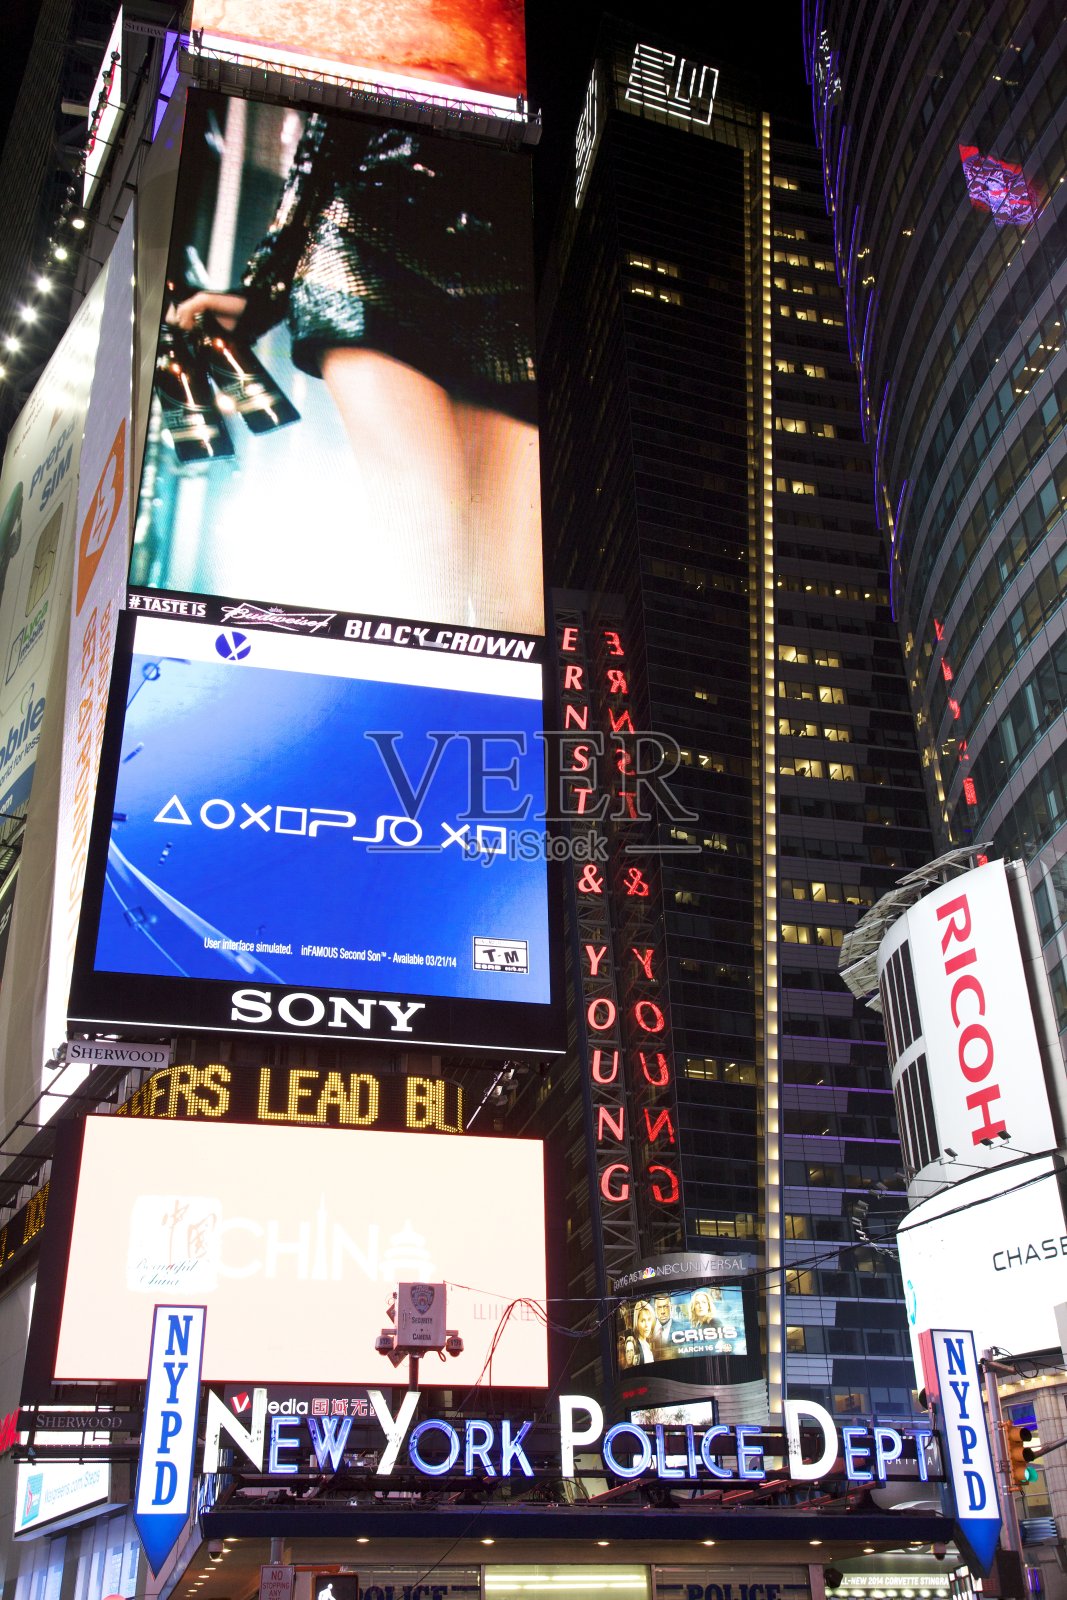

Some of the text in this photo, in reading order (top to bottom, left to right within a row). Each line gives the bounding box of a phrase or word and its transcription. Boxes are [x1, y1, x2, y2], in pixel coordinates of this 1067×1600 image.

[124, 22, 165, 37] SHERW
[39, 443, 73, 512] SIM
[191, 603, 206, 617] IS
[221, 604, 535, 660] Budweiser BLACK CROWN
[562, 627, 629, 1202] ERNST & YOUNG
[204, 937, 221, 949] User
[222, 938, 254, 952] interface
[256, 941, 293, 955] simulated.
[301, 945, 339, 959] inFAMOUS
[339, 948, 366, 961] Second
[393, 952, 424, 966] Available
[425, 955, 457, 968] 03/21/14
[231, 989, 425, 1032] SONY
[936, 893, 1007, 1146] RICOH
[71, 1045, 165, 1064] SHERWOOD
[258, 1067, 379, 1125] LEAD
[671, 1326, 738, 1344] CRISIS
[678, 1344, 714, 1354] MARCH 16
[151, 1314, 194, 1506] NYPD
[266, 1397, 309, 1415] edia
[311, 1397, 380, 1417] 国域无
[36, 1413, 123, 1429] SHERWOOD
[943, 1337, 989, 1512] NYPD
[203, 1387, 934, 1483] NEW YORK POLICE DEPT
[271, 1571, 283, 1581] NO
[841, 1576, 867, 1585] LL-NEW
[885, 1576, 918, 1586] CORVETTE
[920, 1576, 949, 1586] STINGRA
[263, 1582, 290, 1590] STOPPING
[360, 1585, 448, 1600] OLICE
